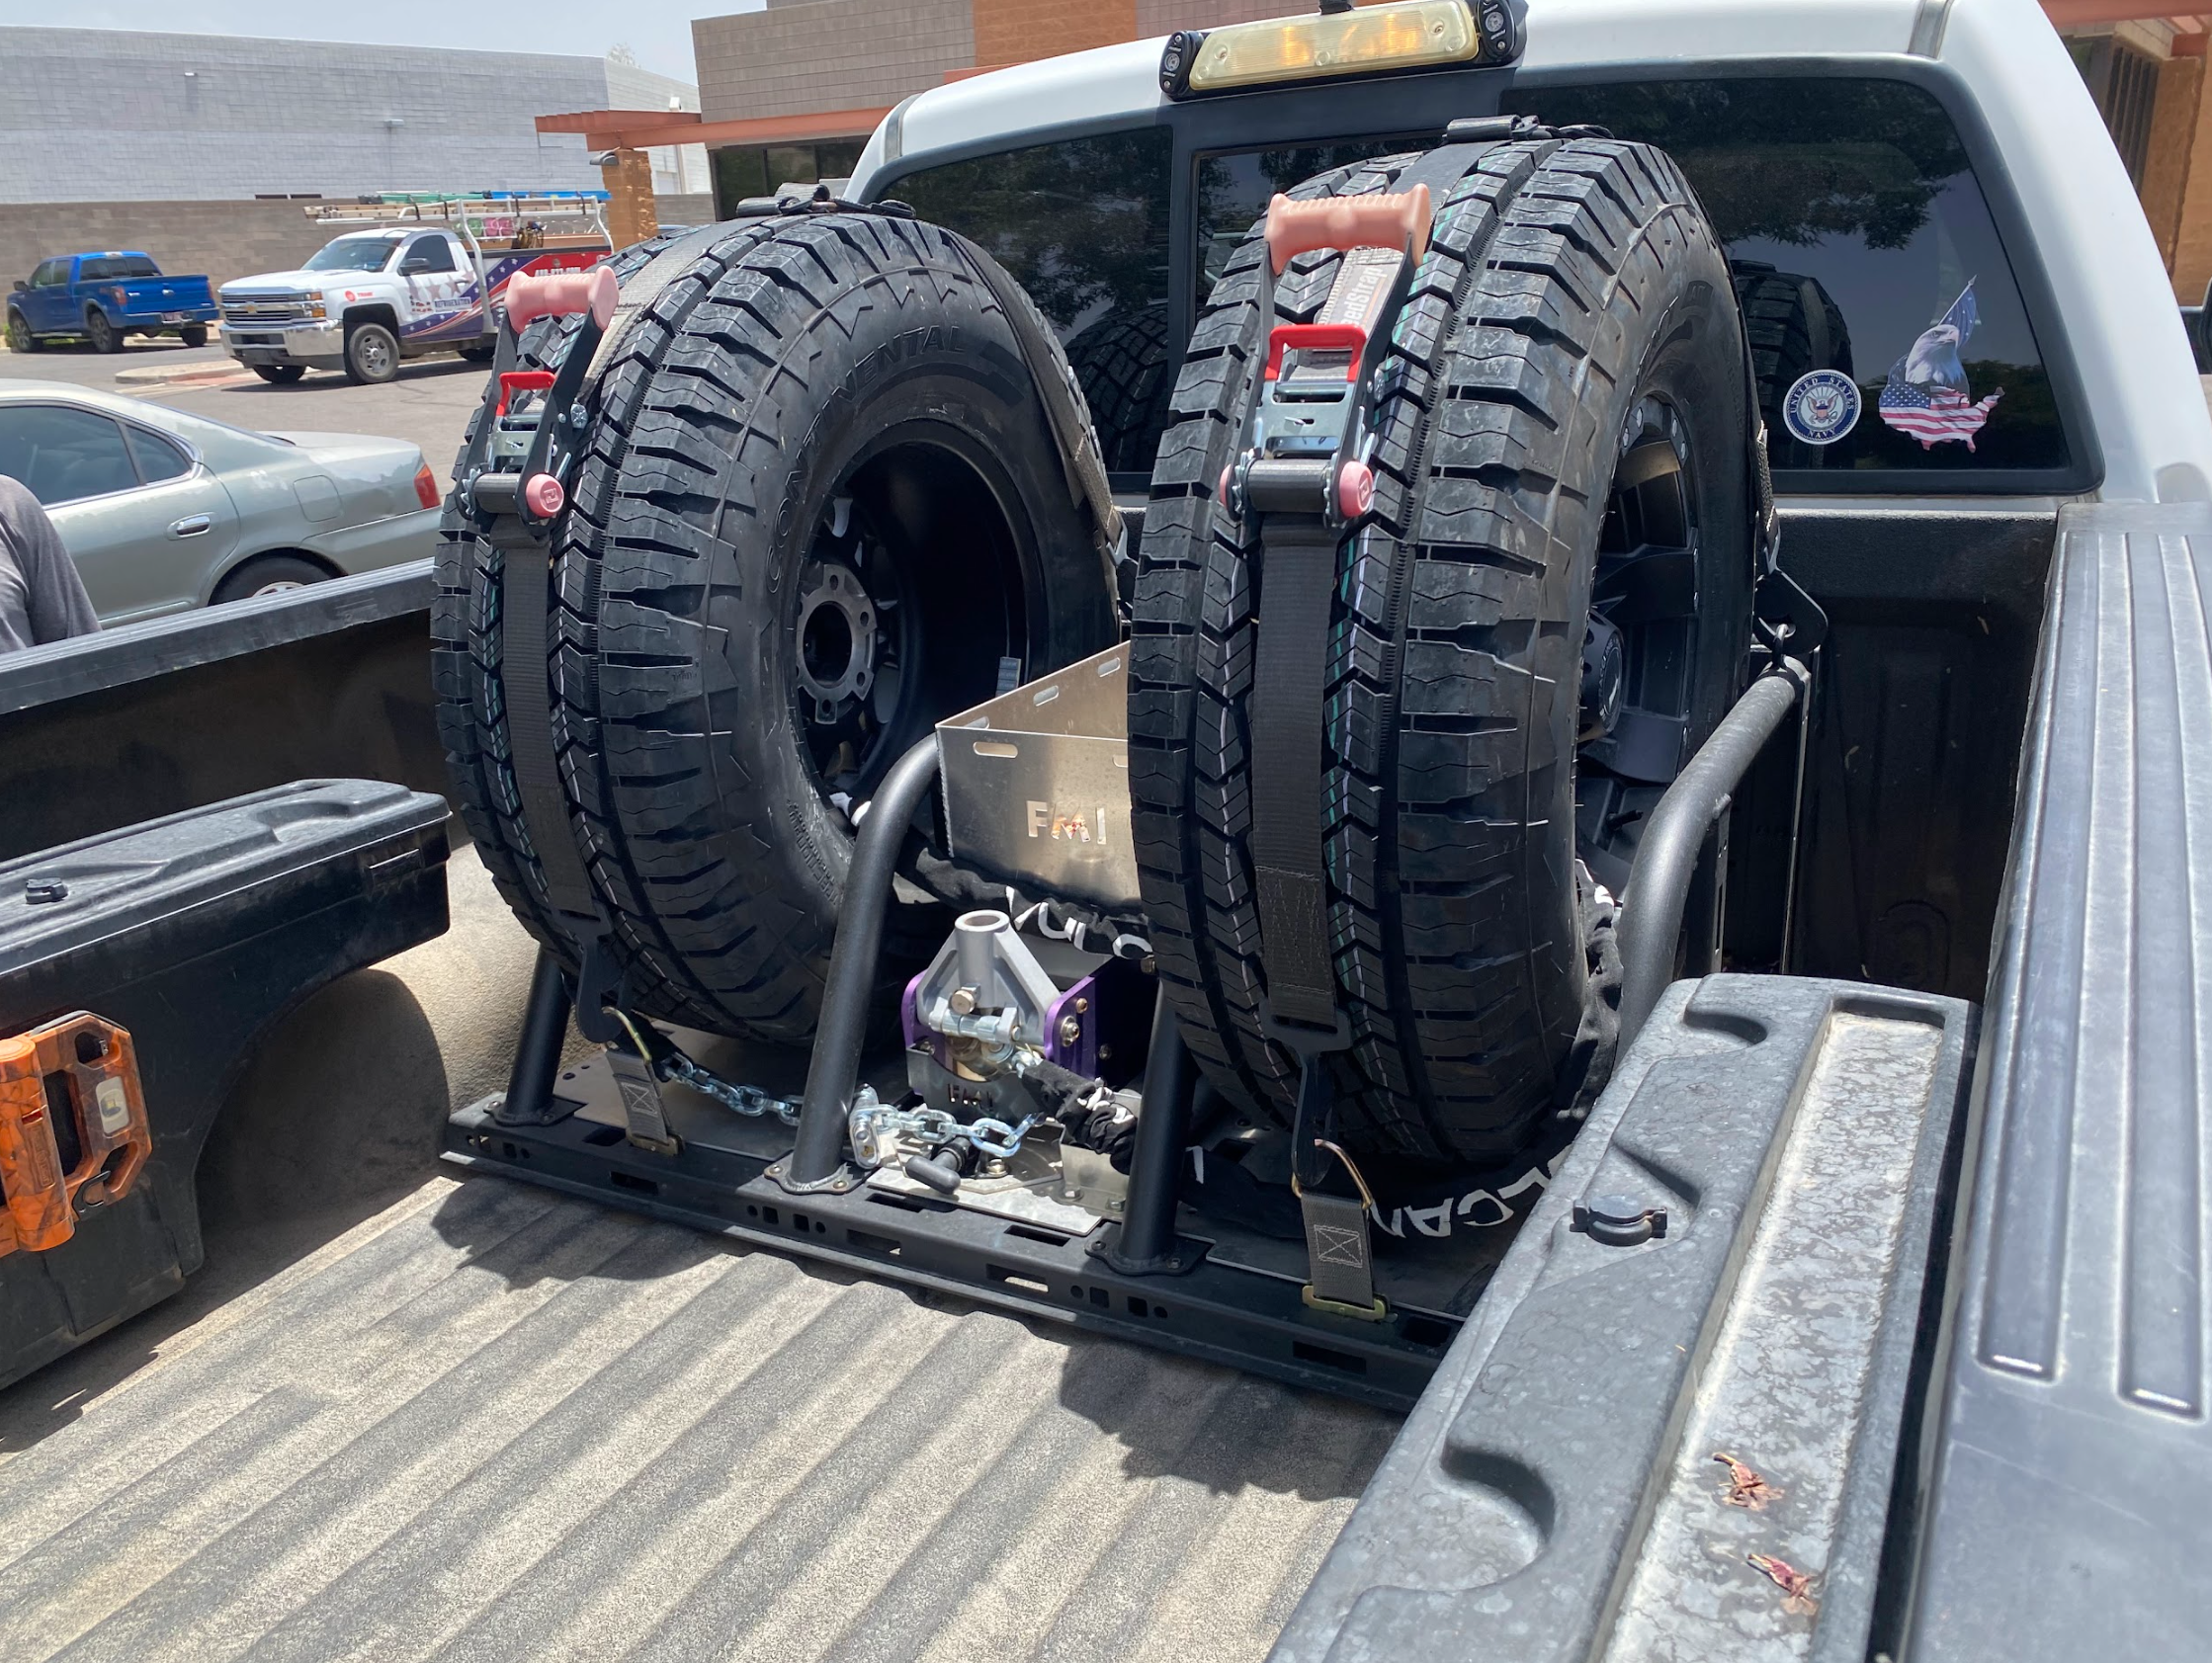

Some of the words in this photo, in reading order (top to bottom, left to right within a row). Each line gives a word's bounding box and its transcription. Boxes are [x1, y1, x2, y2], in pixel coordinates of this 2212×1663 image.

[1790, 377, 1819, 413] UNITED
[1829, 376, 1855, 410] STATES
[1809, 427, 1836, 439] NAVY
[766, 325, 966, 593] CONTINENTAL
[1026, 800, 1107, 845] FMI
